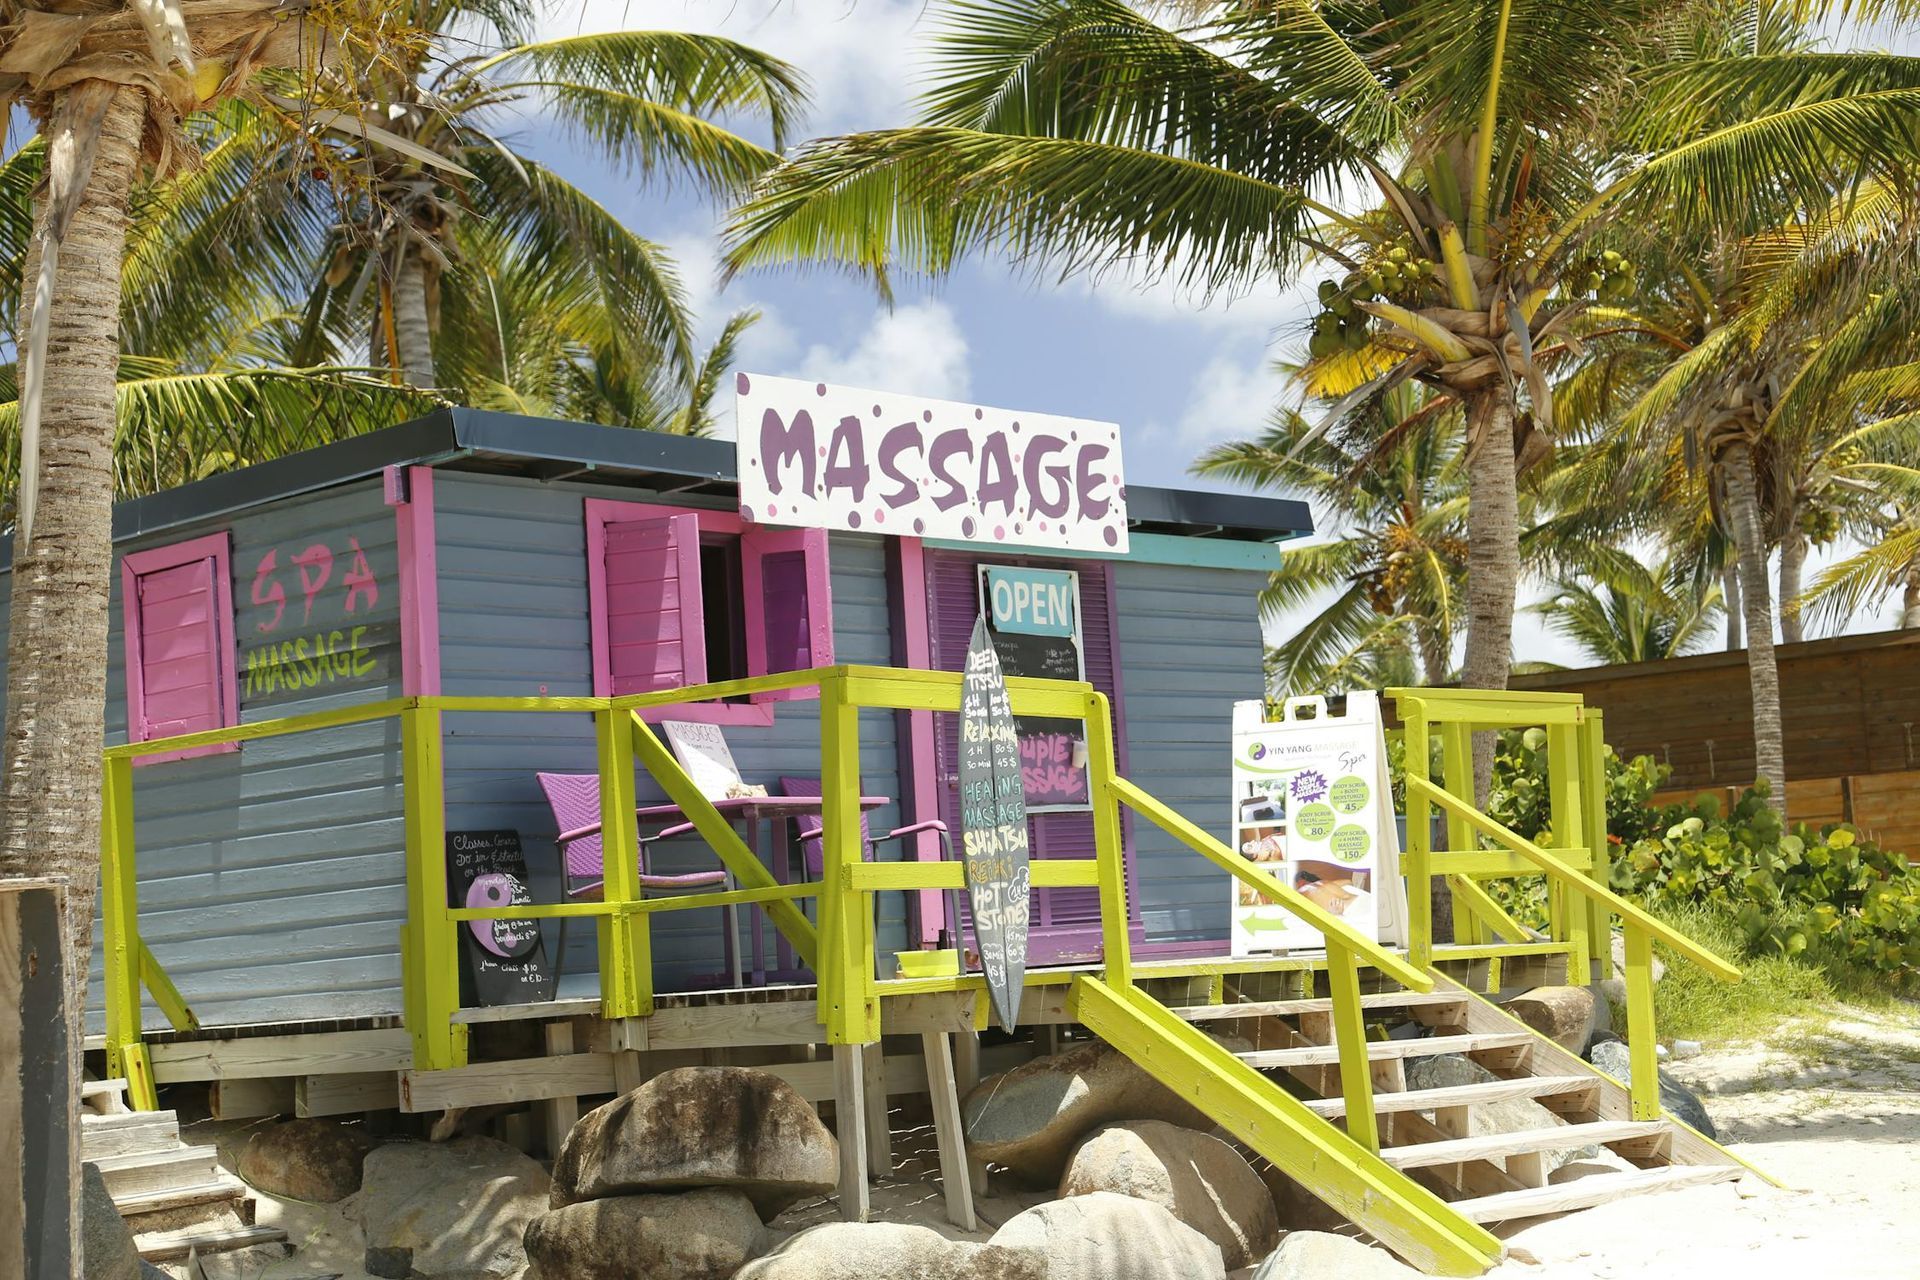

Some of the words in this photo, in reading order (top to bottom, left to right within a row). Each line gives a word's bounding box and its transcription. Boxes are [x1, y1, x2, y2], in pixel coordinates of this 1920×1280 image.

[760, 407, 1110, 524] MASSAGE
[252, 534, 378, 633] SPA
[992, 579, 1069, 627] OPEN
[247, 626, 377, 698] MASSAGE
[969, 648, 1000, 675] DEEP
[1268, 747, 1285, 755] YIN
[1286, 744, 1312, 753] YANG
[1338, 750, 1367, 773] Spa
[1022, 765, 1083, 796] SSAGE
[964, 801, 1024, 828] MASSAGE
